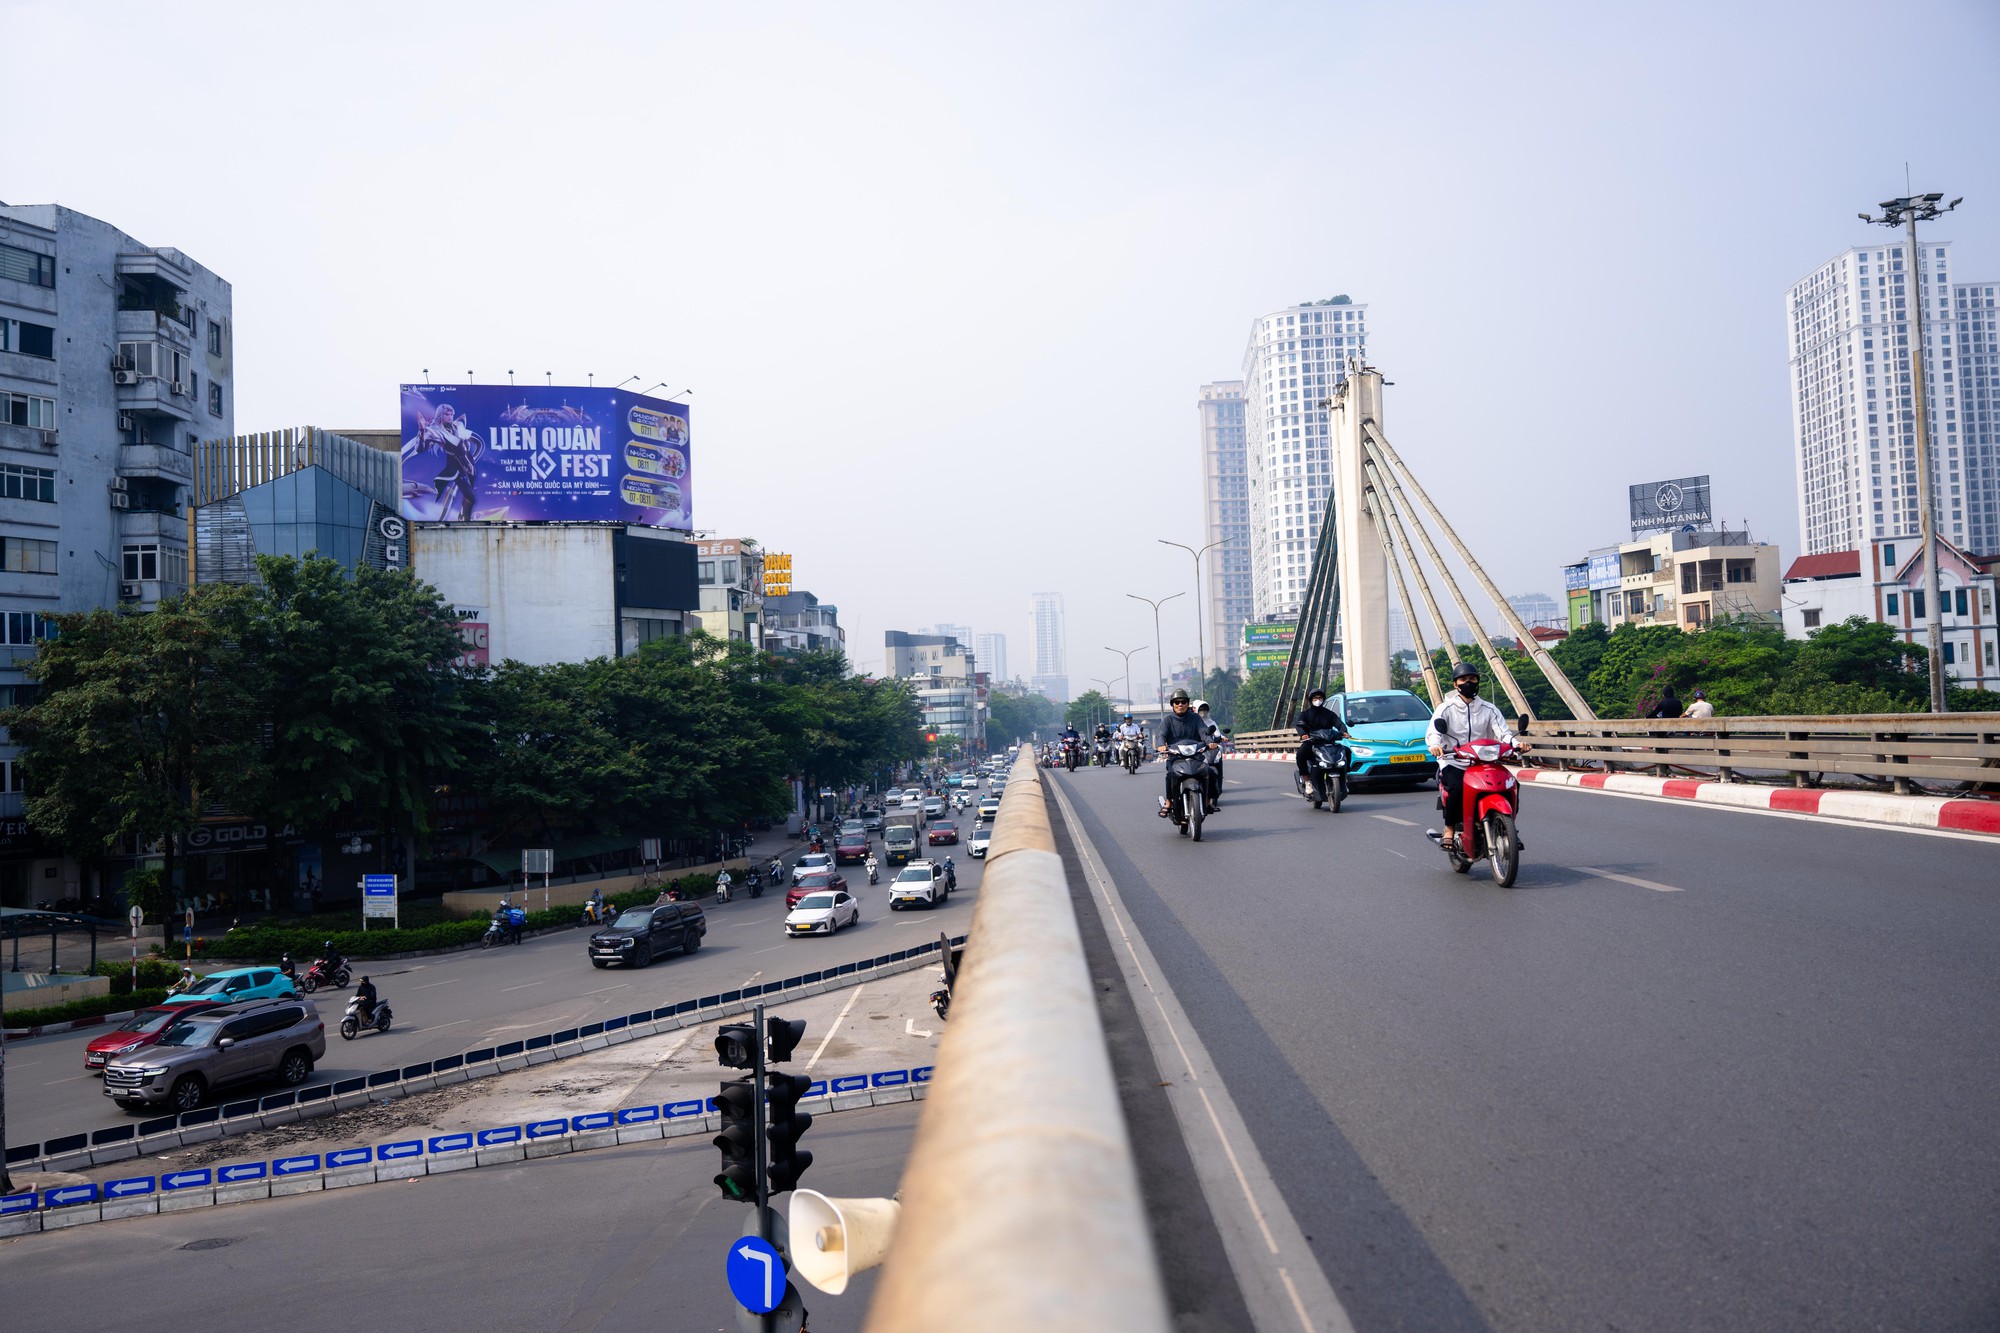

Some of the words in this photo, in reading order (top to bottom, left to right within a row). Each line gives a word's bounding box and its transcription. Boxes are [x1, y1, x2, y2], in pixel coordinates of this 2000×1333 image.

[490, 424, 536, 450] LIÊN
[542, 425, 600, 453] QUÂN
[561, 454, 611, 477] FEST
[498, 480, 510, 489] SÂN
[512, 480, 524, 490] VẬN
[526, 481, 542, 490] ĐỘNG
[544, 480, 560, 489] QUỐC
[585, 481, 599, 489] ĐÌNH
[629, 492, 636, 502] 07
[1632, 517, 1655, 528] KÍNH
[1677, 511, 1708, 522] ANNA
[214, 824, 268, 843] GOLD
